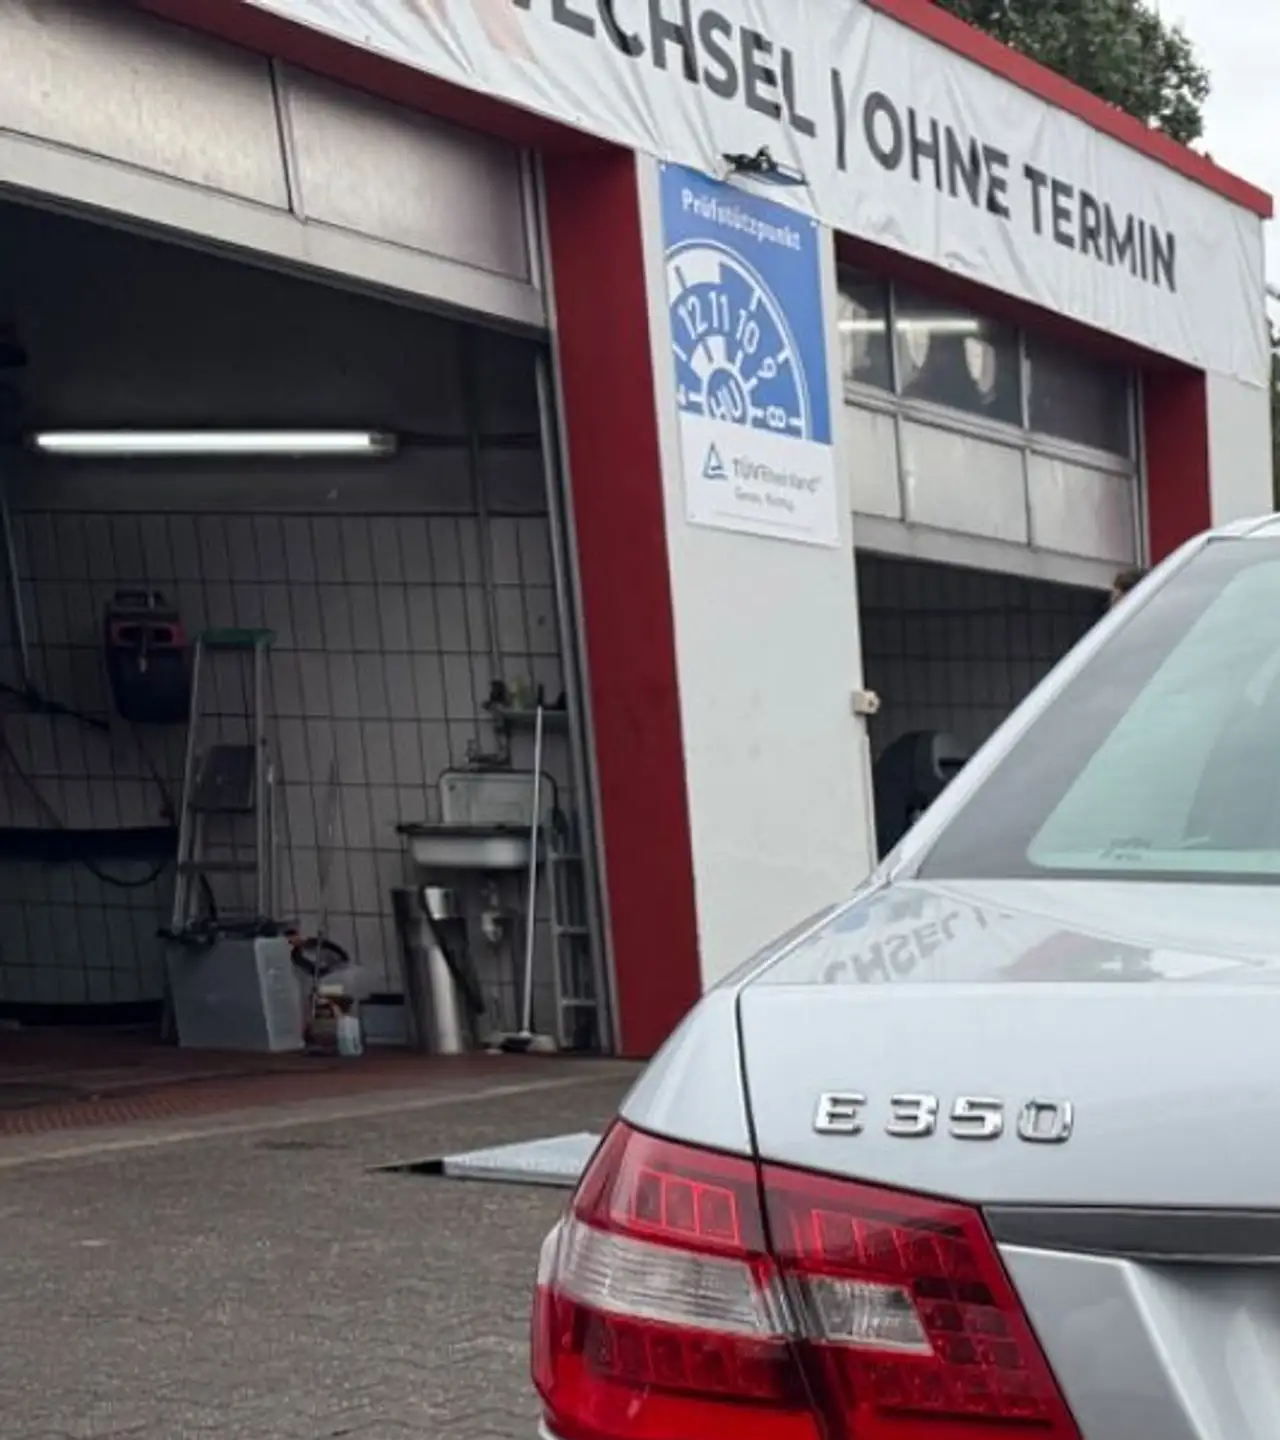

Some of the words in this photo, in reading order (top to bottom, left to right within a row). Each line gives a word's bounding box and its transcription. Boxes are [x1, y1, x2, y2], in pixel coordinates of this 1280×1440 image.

[512, 0, 817, 138] CHSEL
[863, 91, 1010, 220] OHNE
[1024, 163, 1176, 293] TERMIN
[681, 187, 802, 251] Prüfstützpunkt
[678, 295, 708, 340] 12
[708, 291, 730, 332] 11
[736, 308, 760, 353] 10
